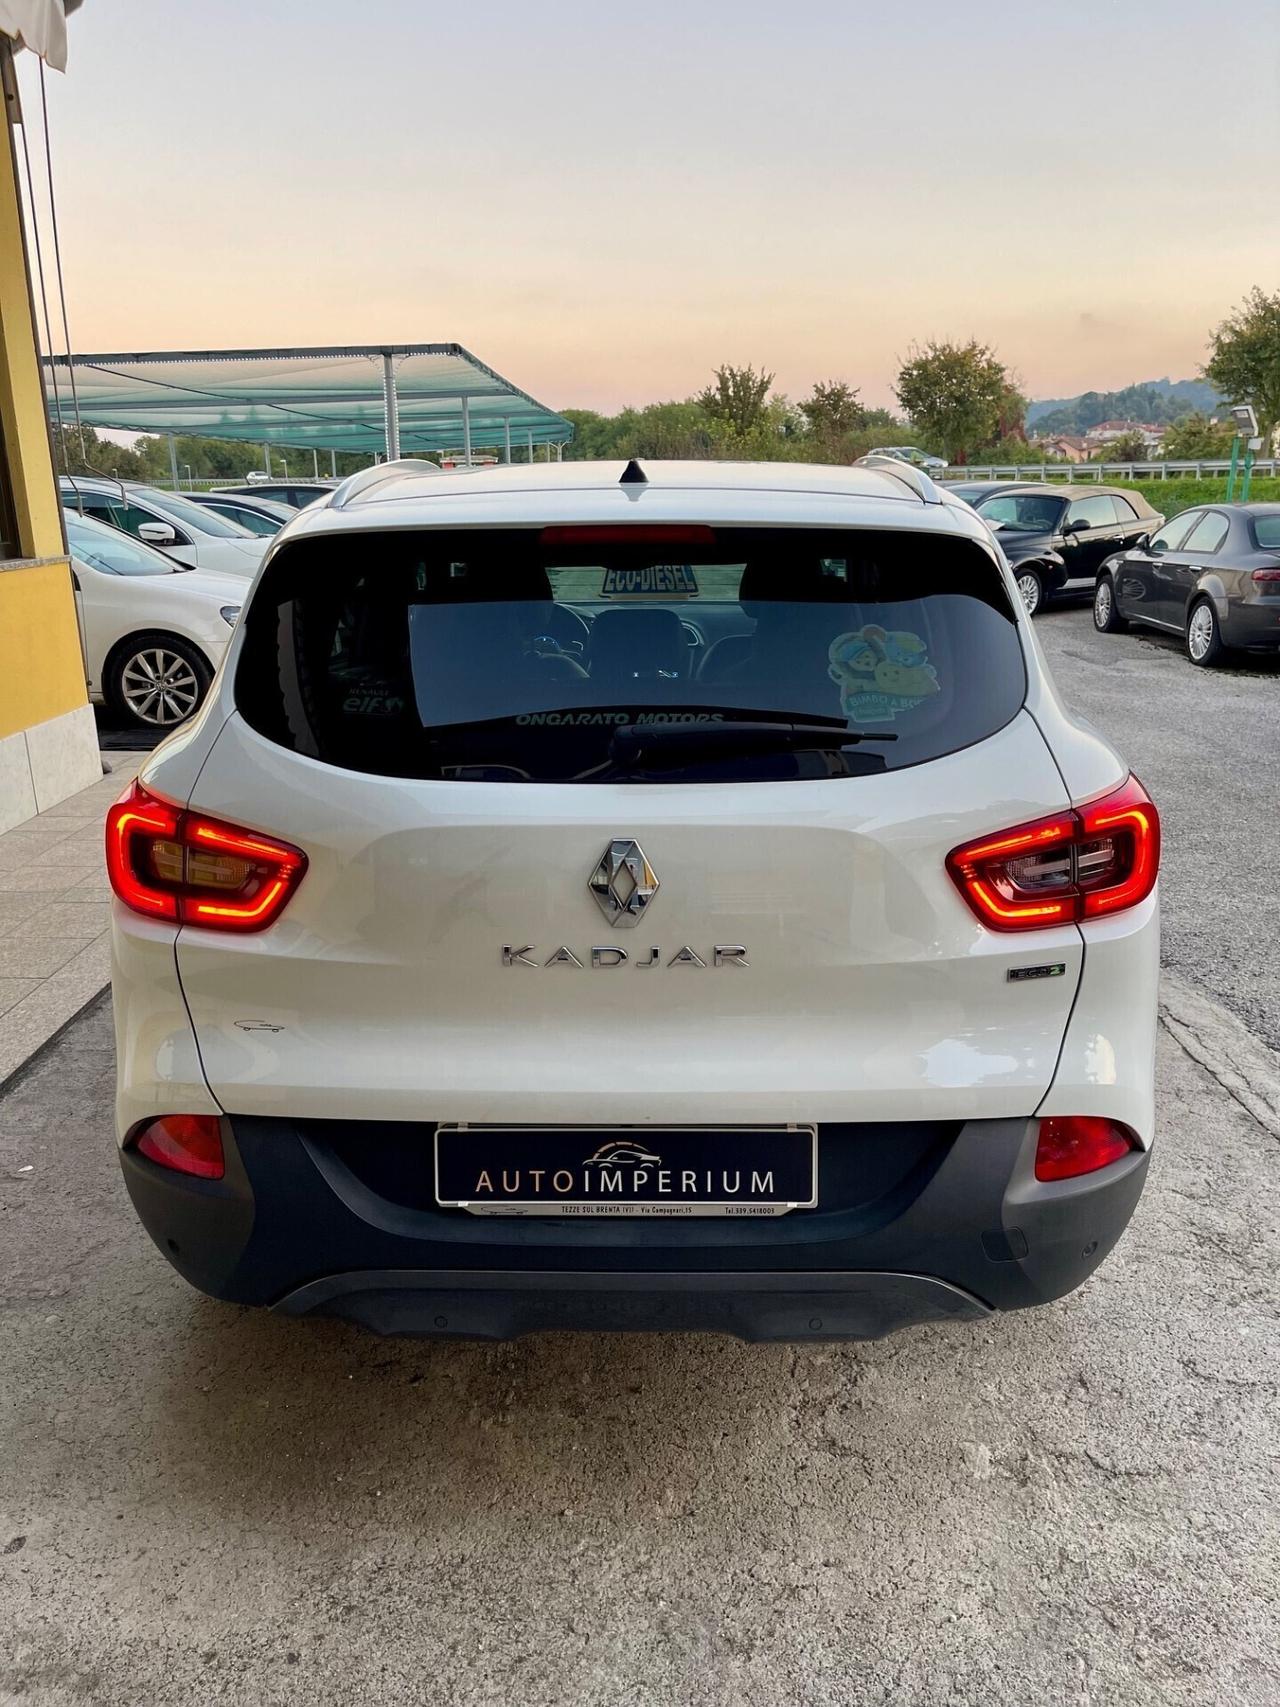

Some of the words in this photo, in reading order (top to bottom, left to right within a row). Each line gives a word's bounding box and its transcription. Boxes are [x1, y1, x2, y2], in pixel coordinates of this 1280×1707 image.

[342, 697, 383, 712] elf
[515, 713, 630, 725] ONGARATO
[636, 713, 725, 725] MOTORS
[502, 945, 750, 968] KADJAR
[475, 1170, 775, 1193] AUTOIMPERIUM
[561, 1205, 580, 1213] TEZZE
[582, 1205, 594, 1213] SUL
[596, 1205, 620, 1213] BRENTA
